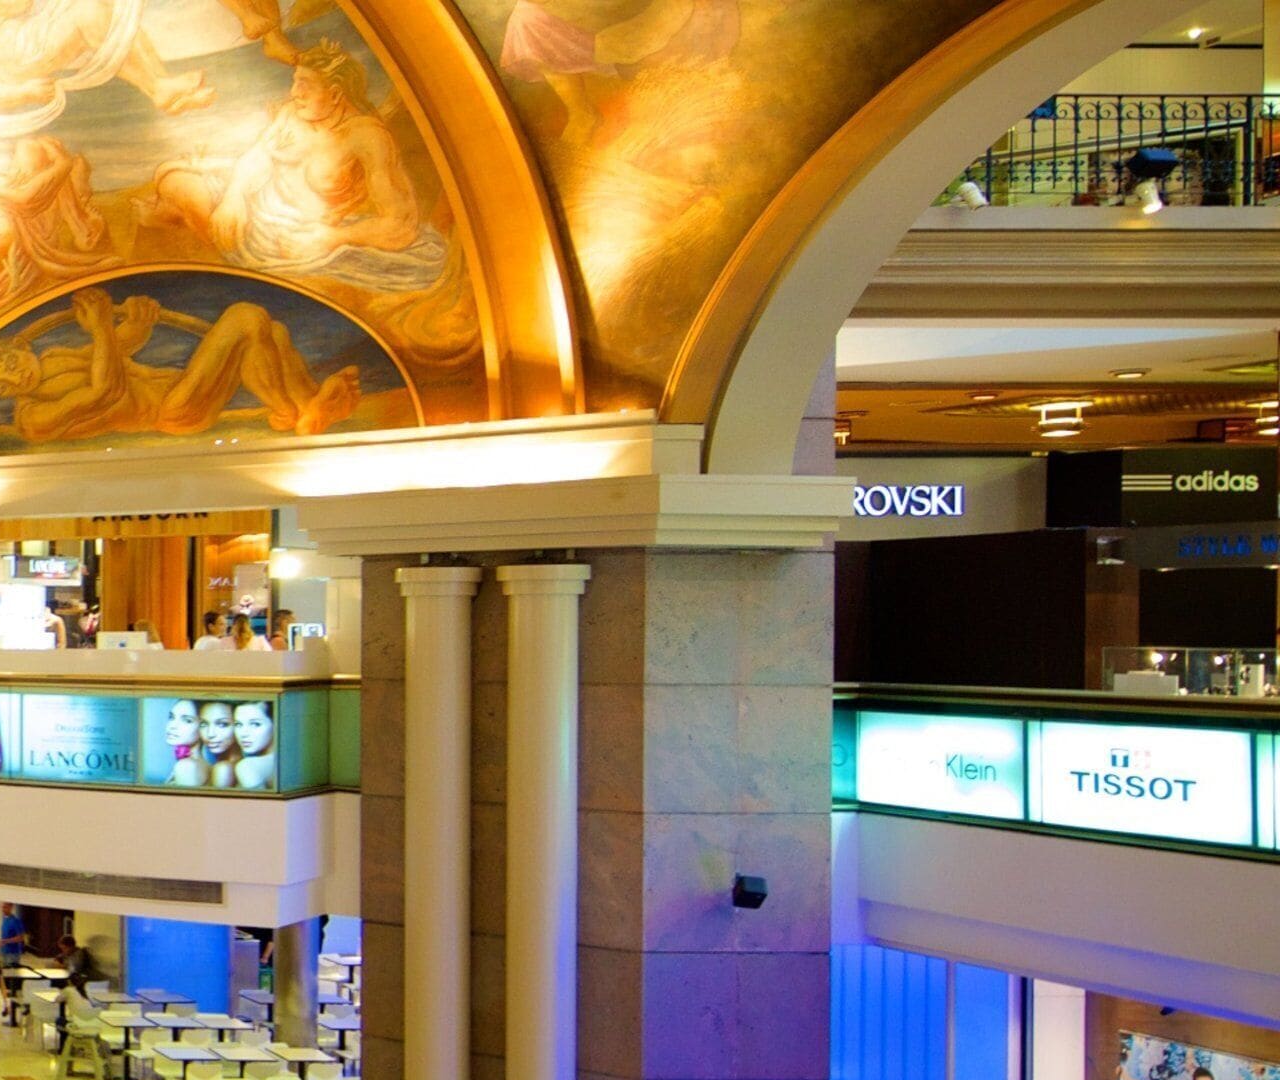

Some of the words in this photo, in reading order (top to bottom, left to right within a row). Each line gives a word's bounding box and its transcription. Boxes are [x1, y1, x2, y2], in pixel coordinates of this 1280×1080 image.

[1175, 470, 1260, 492] adidas
[29, 748, 135, 772] LANCÔME
[945, 752, 997, 782] Klein
[1070, 770, 1197, 802] TISSOT
